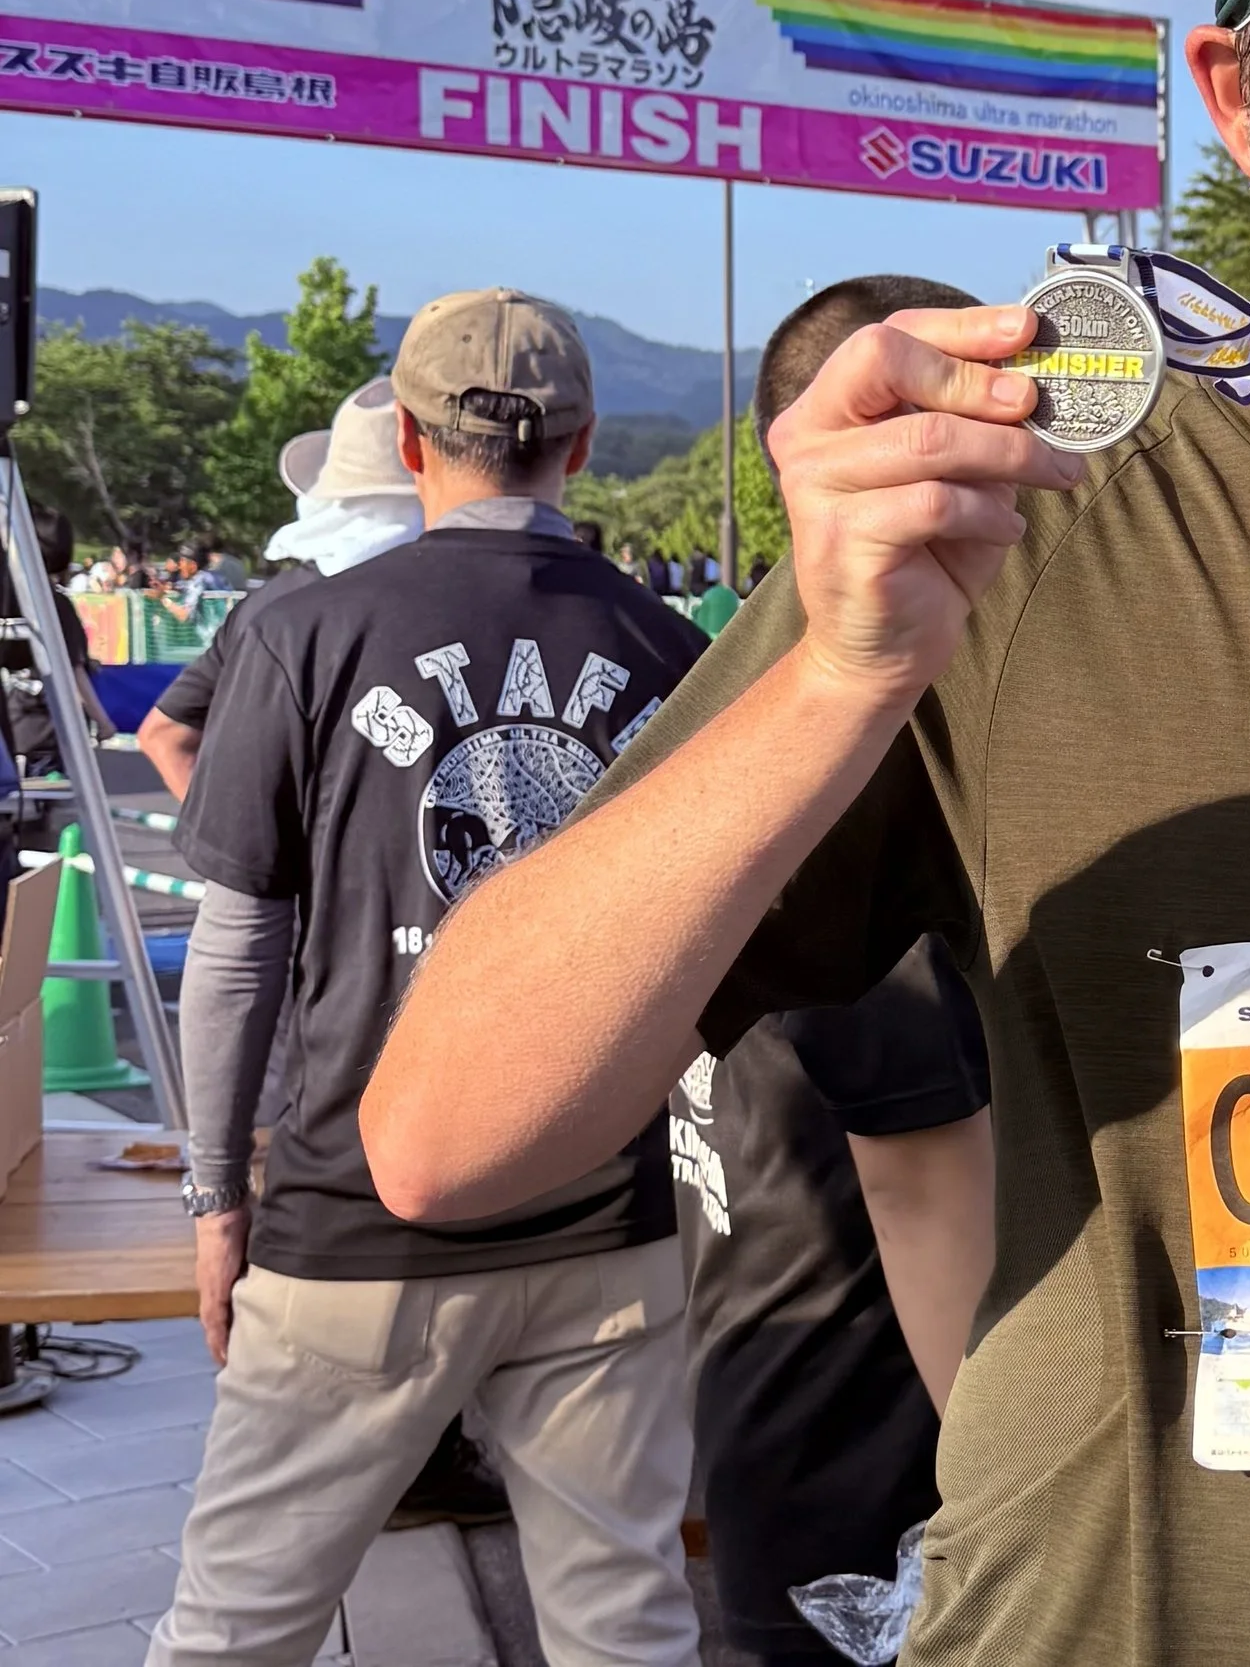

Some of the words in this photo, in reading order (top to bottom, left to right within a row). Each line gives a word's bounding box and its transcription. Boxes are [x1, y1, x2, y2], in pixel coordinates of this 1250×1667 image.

[495, 43, 703, 89] ウルトラマラソン
[419, 68, 763, 172] FINISH
[850, 85, 968, 120] okinoshima
[975, 100, 1019, 127] ultra
[1027, 109, 1117, 134] marathon
[908, 136, 1107, 192] SUZUKI
[1059, 315, 1110, 338] 50km
